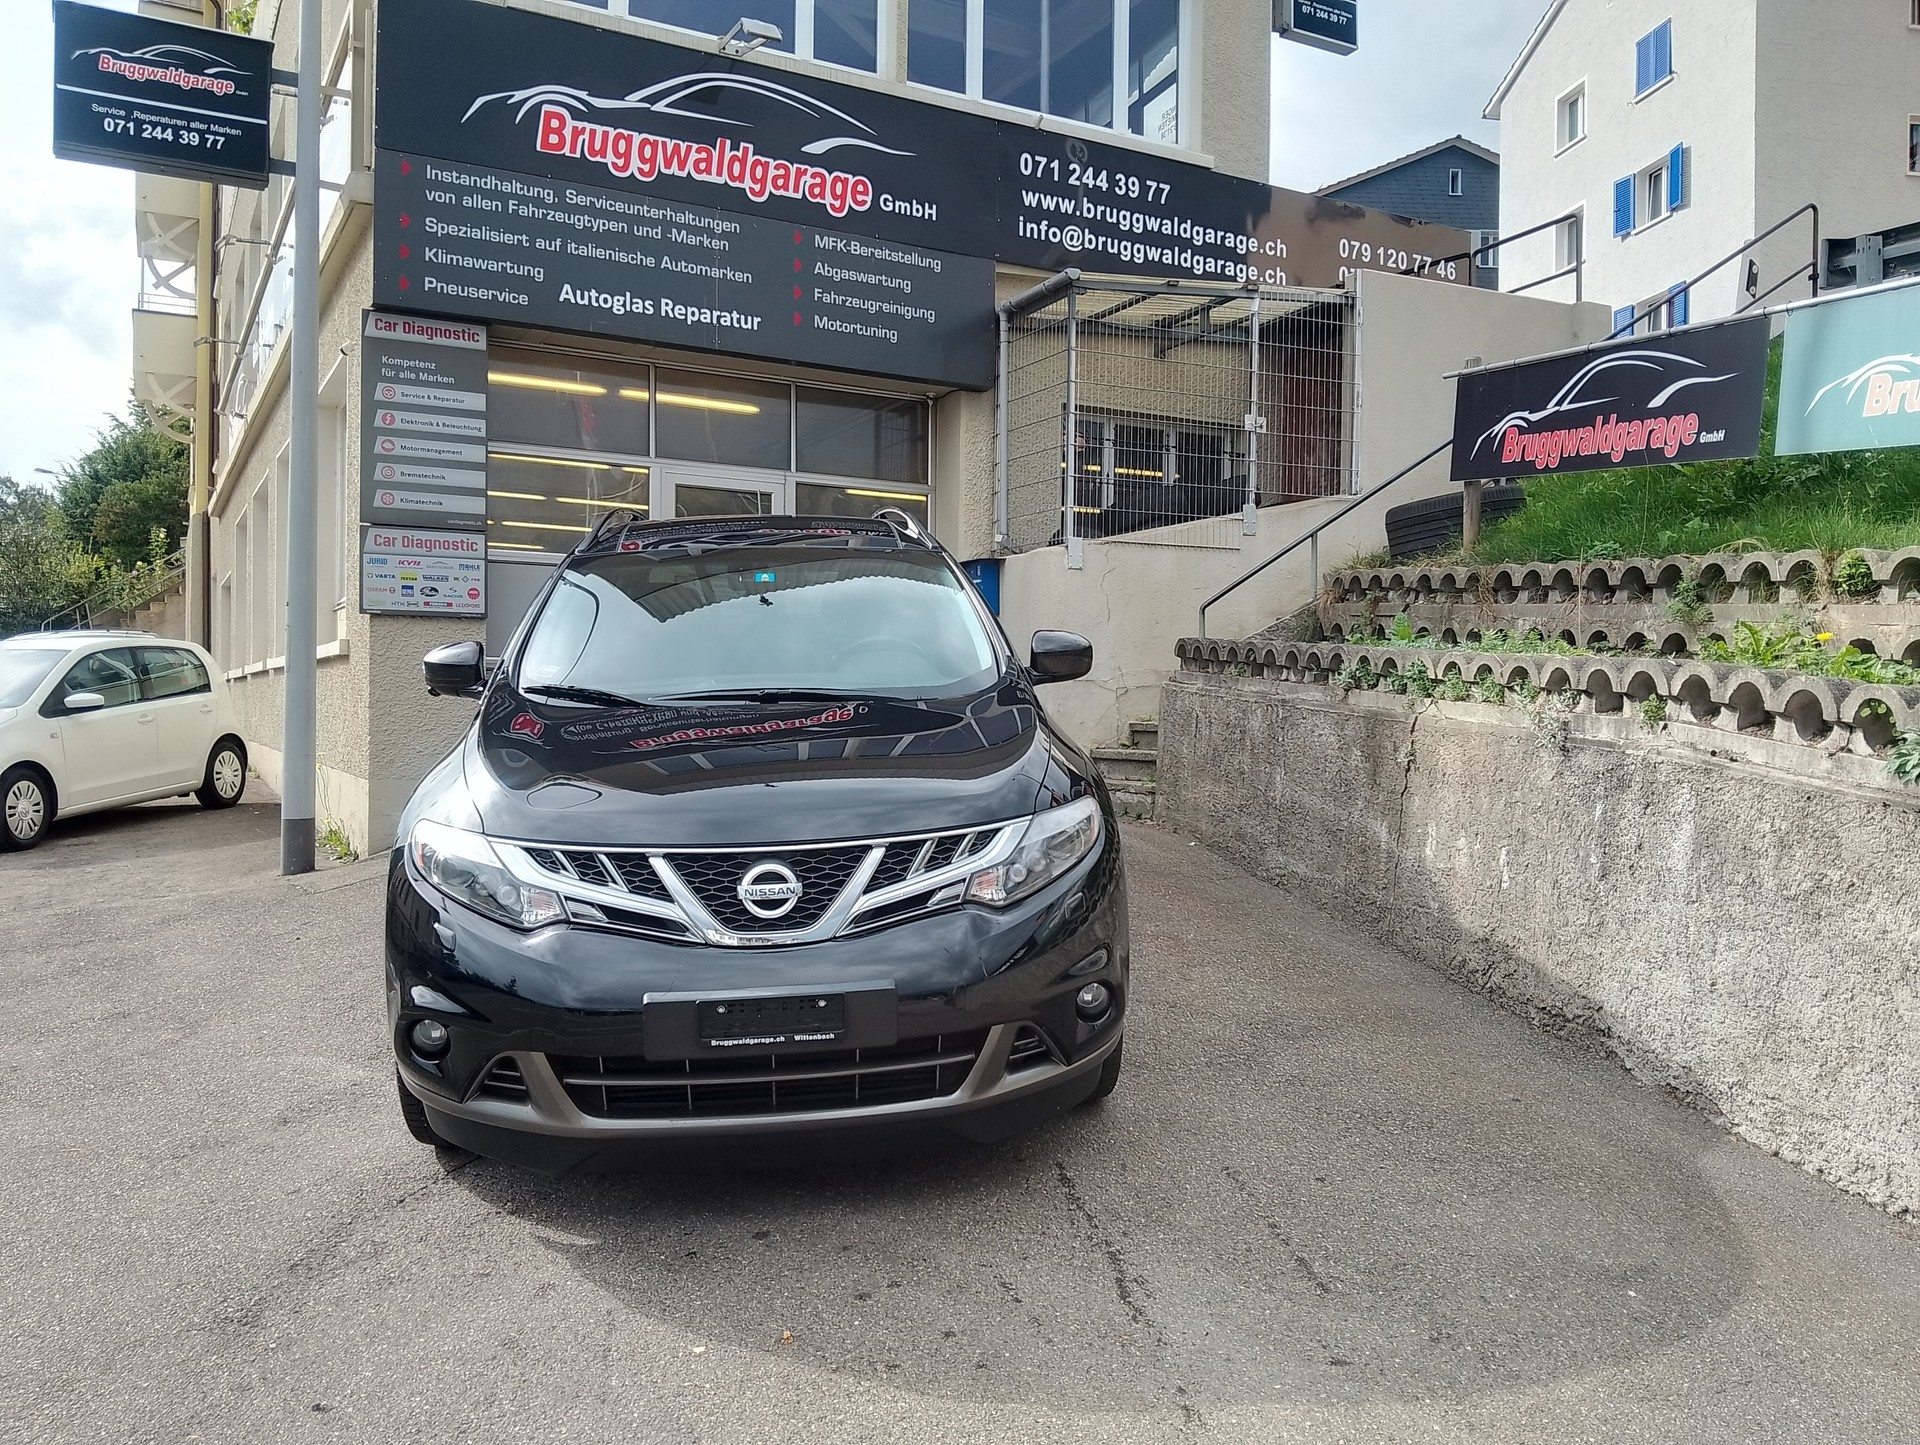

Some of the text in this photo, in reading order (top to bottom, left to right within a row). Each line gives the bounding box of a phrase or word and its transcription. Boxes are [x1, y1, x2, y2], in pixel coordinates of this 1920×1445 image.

[1302, 5, 1314, 16] 071
[1316, 9, 1328, 20] 244
[1330, 13, 1338, 23] 39
[1339, 16, 1347, 25] 77
[98, 54, 235, 96] Bruggwaldgarage
[91, 103, 126, 117] Service
[189, 121, 209, 131] aller
[210, 123, 242, 136] Marken
[104, 118, 226, 150] 071 244 39 77
[536, 104, 938, 221] Bruggwaldgarage GmbH
[1019, 152, 1171, 204] 071 244 39 77
[426, 163, 740, 234] Instandhaltung, Serviceunterhaltungen
[425, 189, 729, 251] von allen Fahrzeugtypen und -Marken
[1021, 188, 1287, 258] www.bruggwaldgarage.ch
[424, 217, 753, 284] Spezialisiert auf italienische Automarken
[424, 246, 544, 282] Klimawartung
[814, 234, 942, 272] MFK-Bereitstellung
[1018, 215, 1287, 285] info@bruggwaldgarage.ch
[1339, 238, 1457, 281] 079 120 77 46
[424, 276, 529, 305] Pneuservice
[813, 261, 912, 293] Abgaswartung
[559, 283, 762, 331] Autoglas Reparatur
[813, 288, 936, 323] Fahrzeugreinigung
[374, 318, 480, 343] Car Diagnostic
[813, 314, 899, 343] Motortuning
[381, 355, 436, 370] Kompetenz
[381, 368, 455, 384] für alle Marken
[400, 391, 425, 400] Service
[433, 395, 466, 404] Reparatur
[400, 418, 434, 427] Elektronik
[442, 422, 482, 432] Beleuchtung
[1501, 412, 1726, 470] Bruggwaldgarage GmbH
[400, 445, 463, 456] Motormanagement
[400, 471, 446, 480] Bremstechnik
[400, 498, 443, 506] Klimatechnik
[373, 533, 479, 552] Car Diagnostic
[744, 886, 796, 897] NISSAN
[711, 1033, 834, 1047] Bruggwaldgarage.ch Wittenbach
